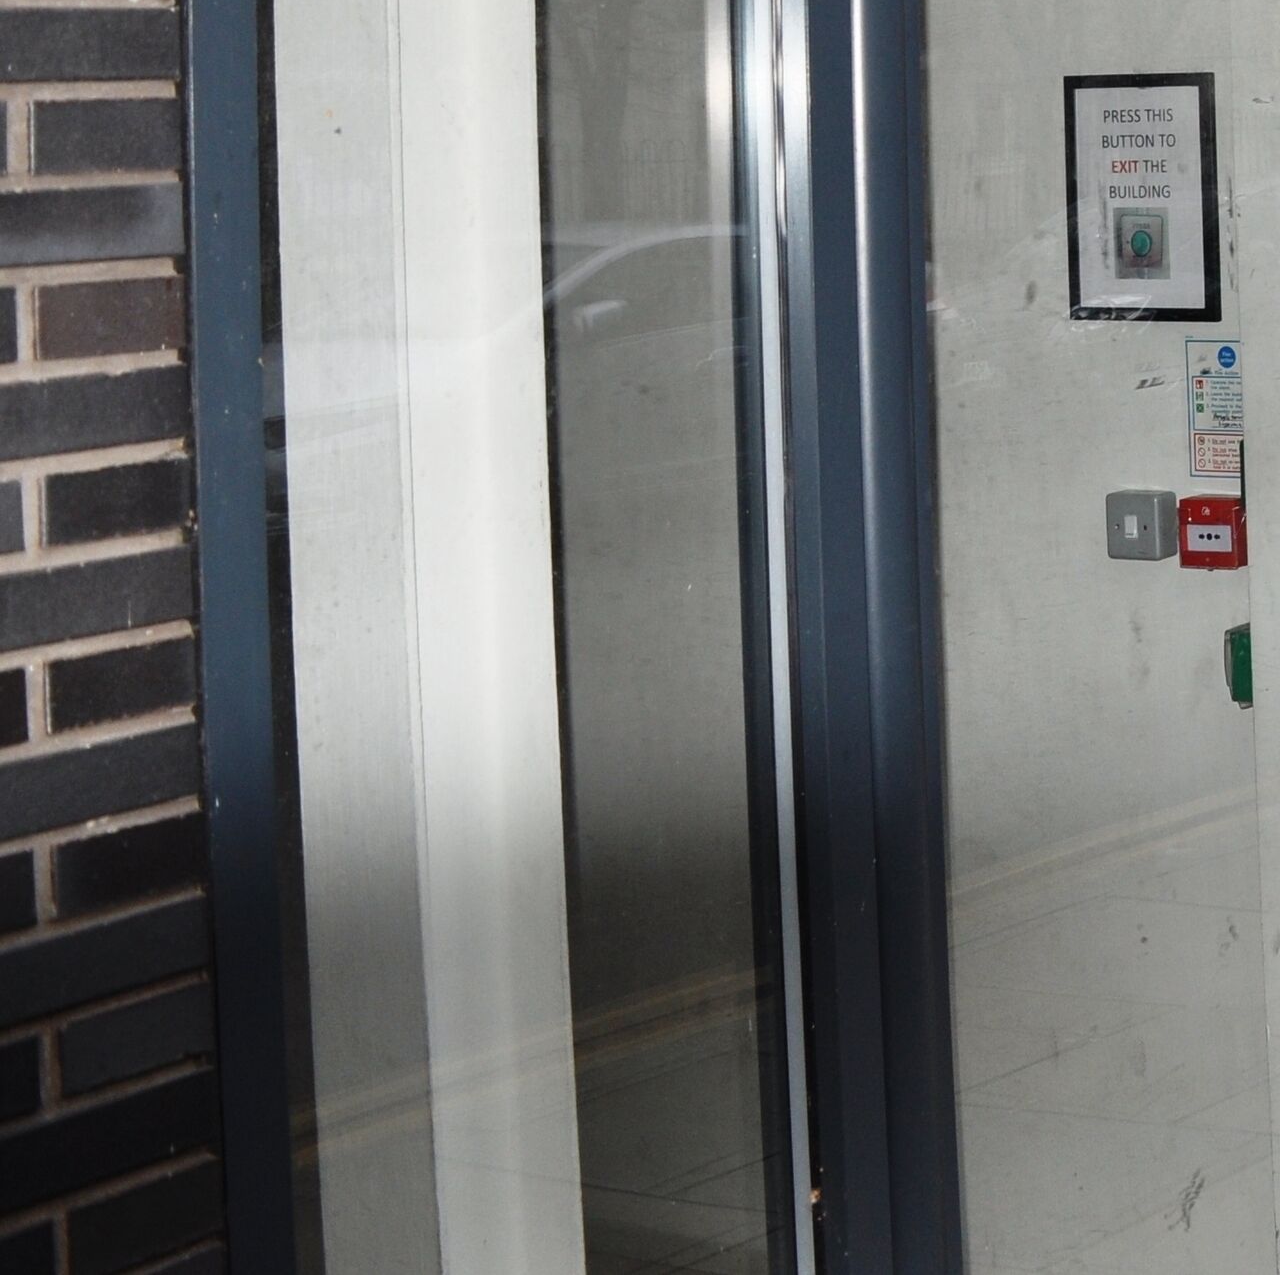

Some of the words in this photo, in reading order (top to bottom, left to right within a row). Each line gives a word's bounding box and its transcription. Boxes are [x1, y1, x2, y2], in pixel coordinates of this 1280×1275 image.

[1103, 109, 1141, 123] PRESS
[1144, 108, 1173, 122] THIS
[1102, 134, 1154, 149] BUTTON
[1158, 133, 1176, 147] TO
[1111, 160, 1138, 173] EXIT
[1143, 159, 1167, 173] THE
[1109, 185, 1171, 199] BUILDING
